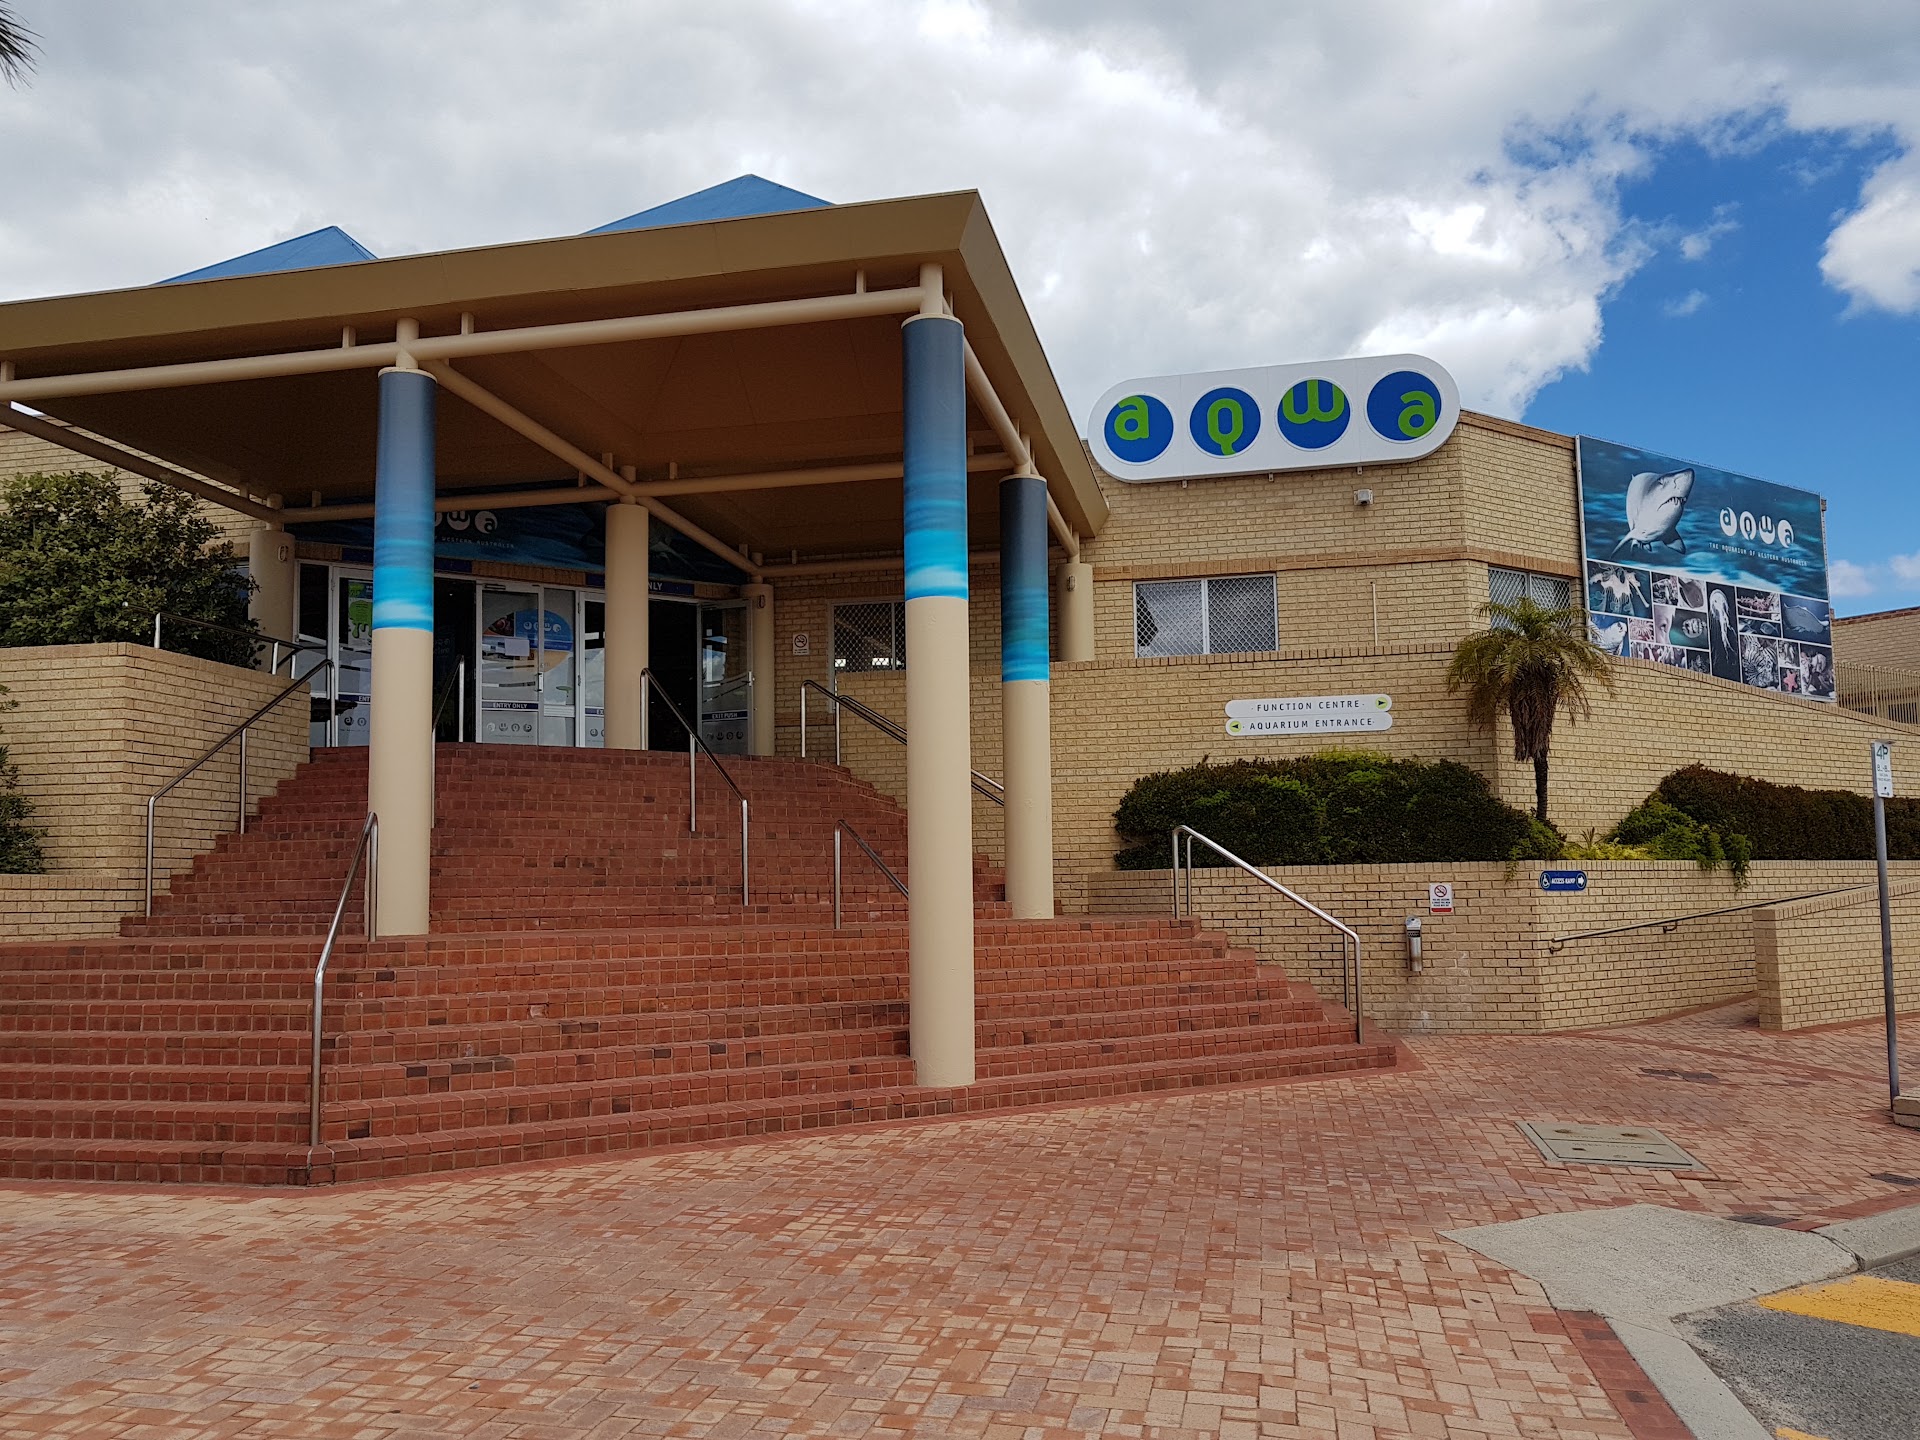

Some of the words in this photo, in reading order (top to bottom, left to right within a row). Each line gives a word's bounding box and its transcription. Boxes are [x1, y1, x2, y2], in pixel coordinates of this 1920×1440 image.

[1722, 544, 1747, 555] AQUARIUM
[1758, 552, 1779, 561] WESTERN
[1257, 702, 1312, 711] FUNCTION
[1318, 700, 1360, 709] CENTRE
[1249, 720, 1309, 730] AQUARIUM
[1315, 717, 1373, 728] ENTRANCE
[1876, 744, 1889, 760] 4P
